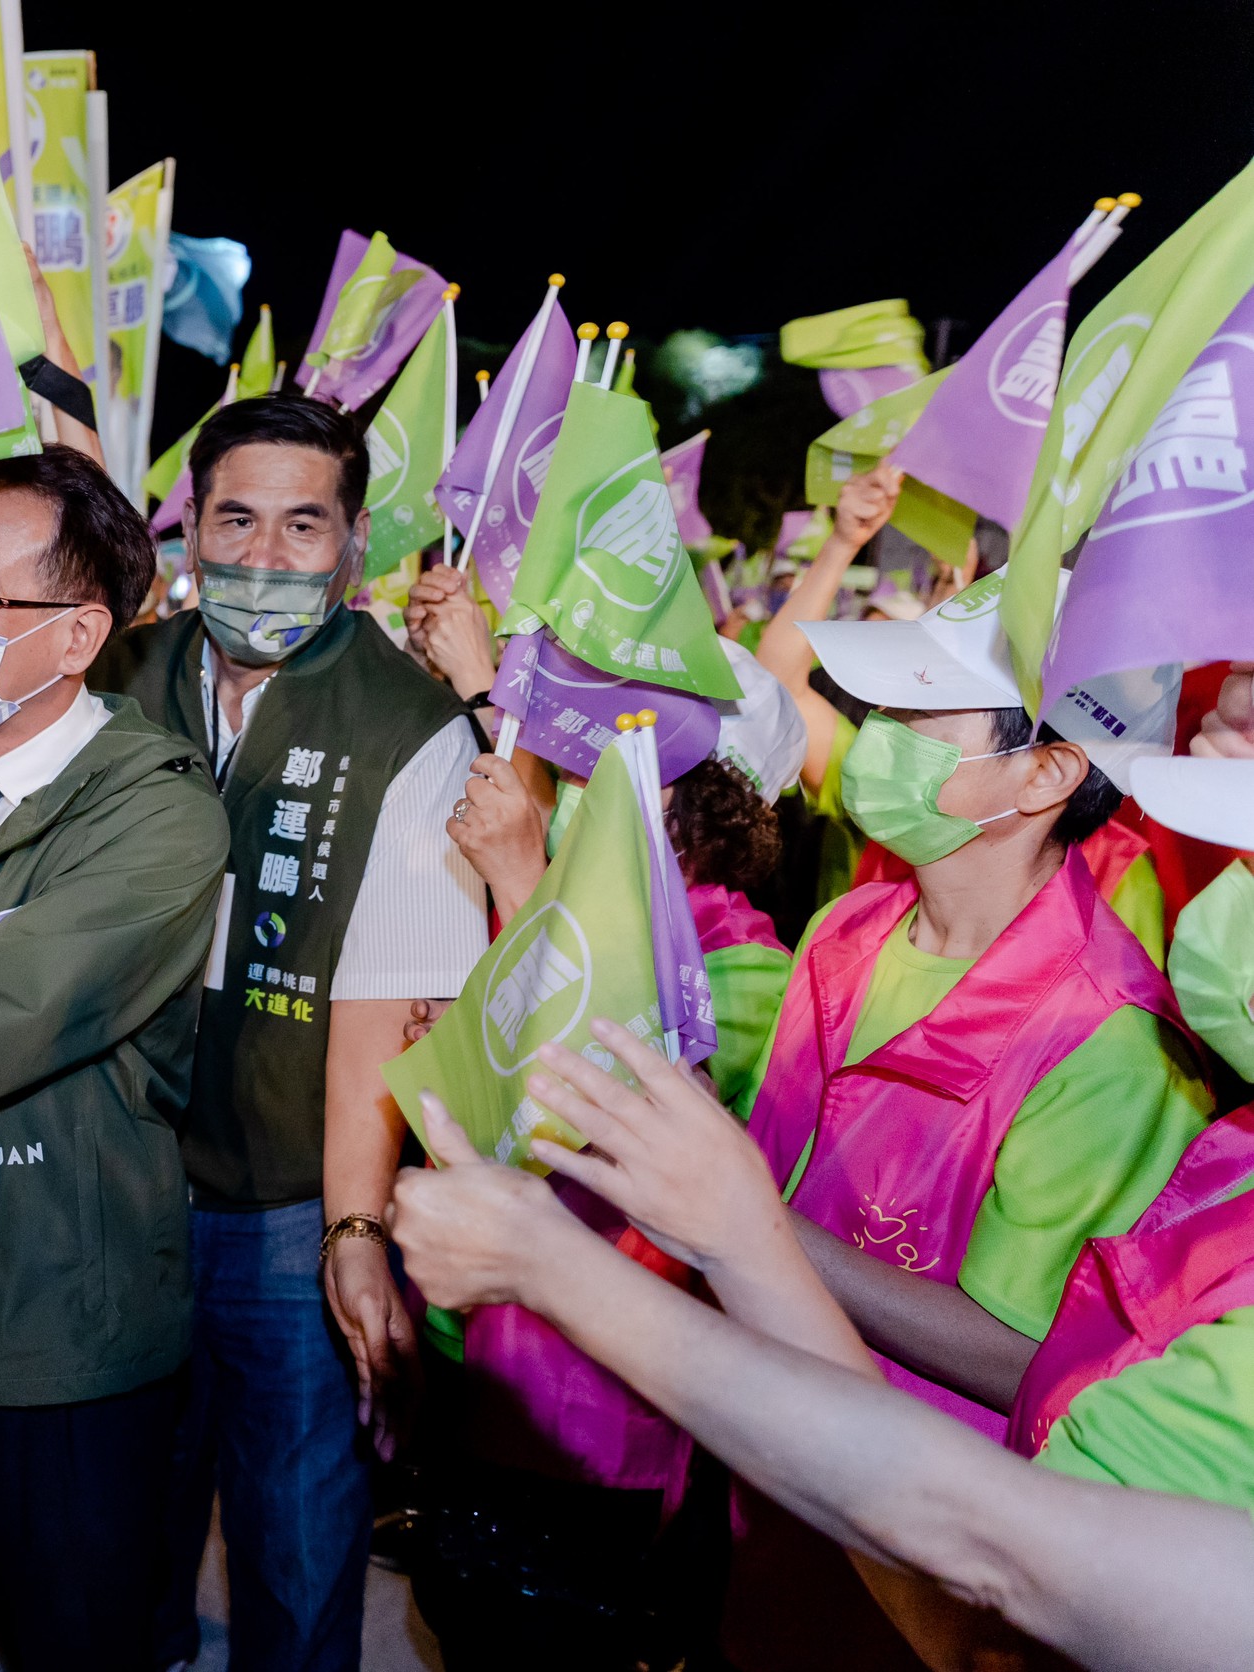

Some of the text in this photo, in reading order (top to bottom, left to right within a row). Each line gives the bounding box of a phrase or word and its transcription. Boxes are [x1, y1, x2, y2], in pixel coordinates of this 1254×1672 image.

[610, 637, 689, 674] 鄭運鵬
[258, 746, 327, 898] 鄭運鵬
[308, 755, 351, 903] 桃園市長候選人
[248, 963, 317, 995] 運轉桃園
[244, 987, 314, 1023] 大進化
